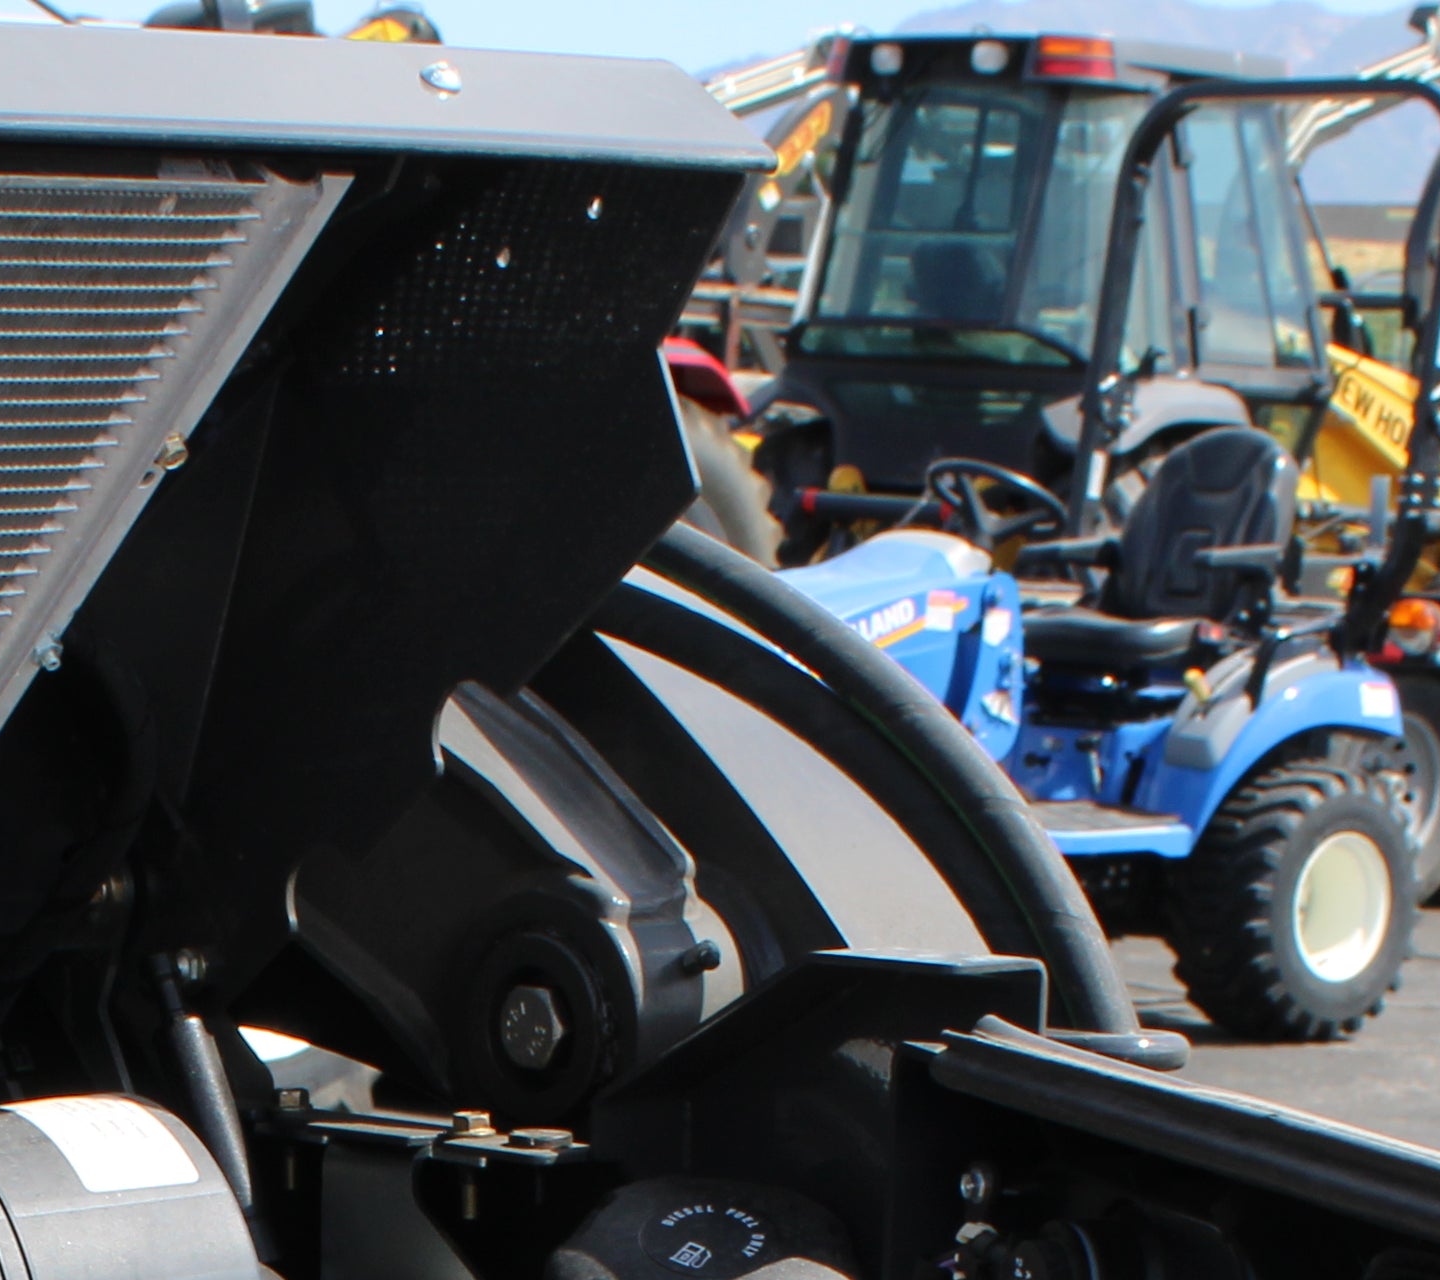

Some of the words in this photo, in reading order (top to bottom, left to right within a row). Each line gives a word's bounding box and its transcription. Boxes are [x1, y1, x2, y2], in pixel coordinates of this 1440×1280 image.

[661, 1204, 715, 1227] DIESEL
[725, 1208, 759, 1228] FUEL
[741, 1233, 765, 1258] ONLY
